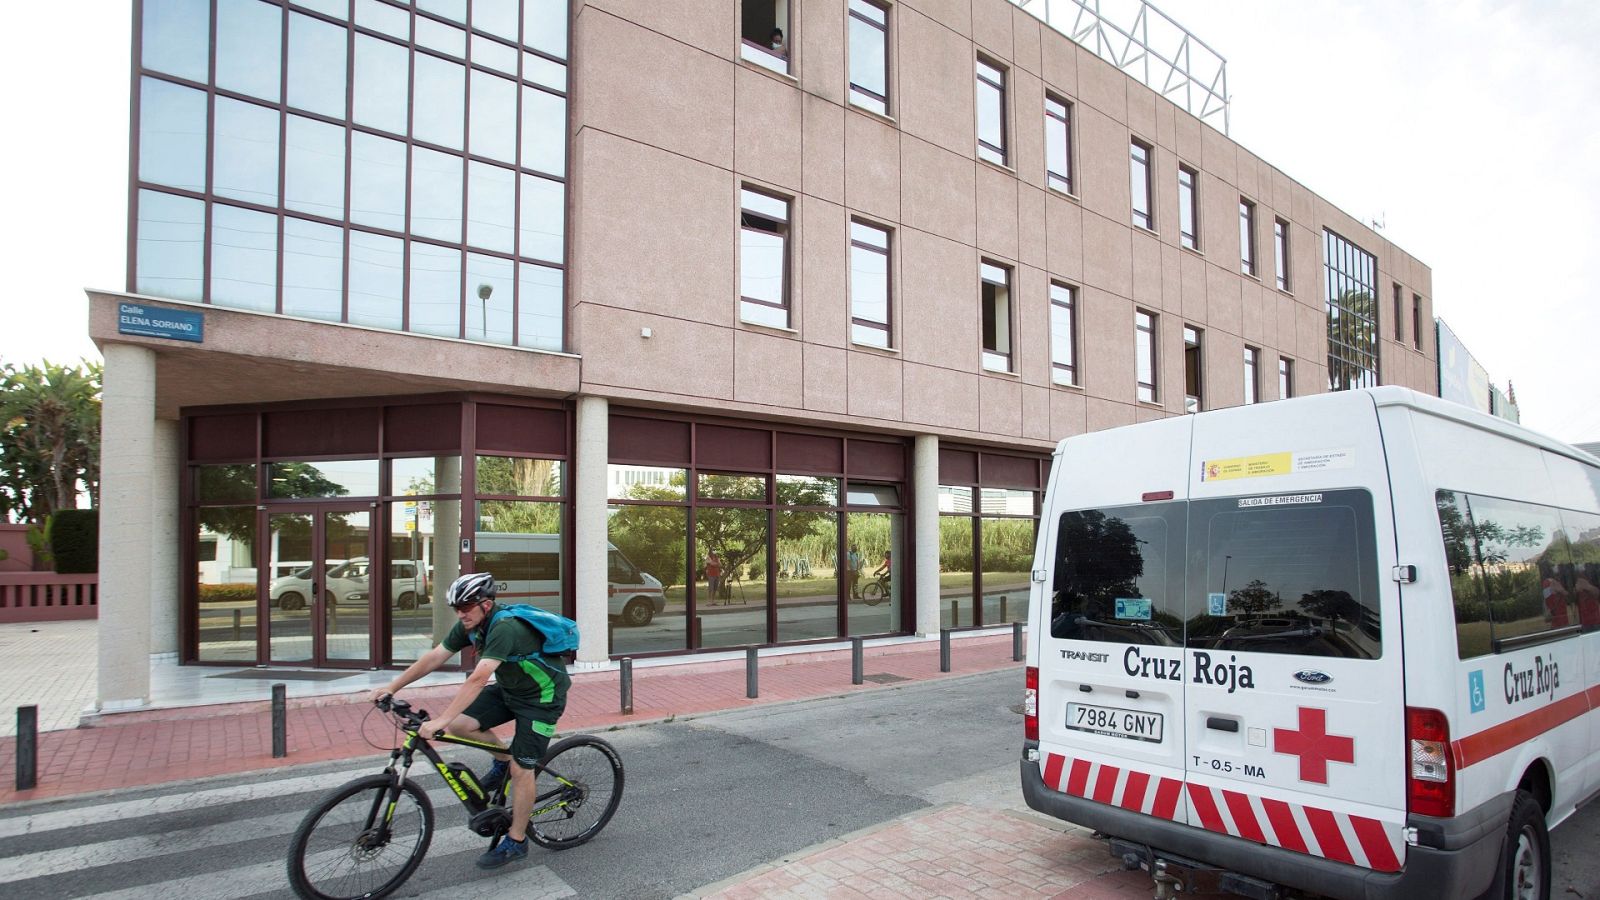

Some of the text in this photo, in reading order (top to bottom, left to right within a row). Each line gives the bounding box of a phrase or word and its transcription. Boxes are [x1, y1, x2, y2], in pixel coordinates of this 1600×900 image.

[120, 304, 144, 315] Calle
[120, 315, 193, 331] ELENA SORIANO
[1239, 495, 1322, 507] SALIDA DE EMERGENCIA
[1060, 650, 1110, 663] TRANSIT
[1123, 646, 1255, 693] Cruz Roja
[1504, 653, 1560, 704] Cruz Roja
[1077, 707, 1156, 735] 7984 GNY
